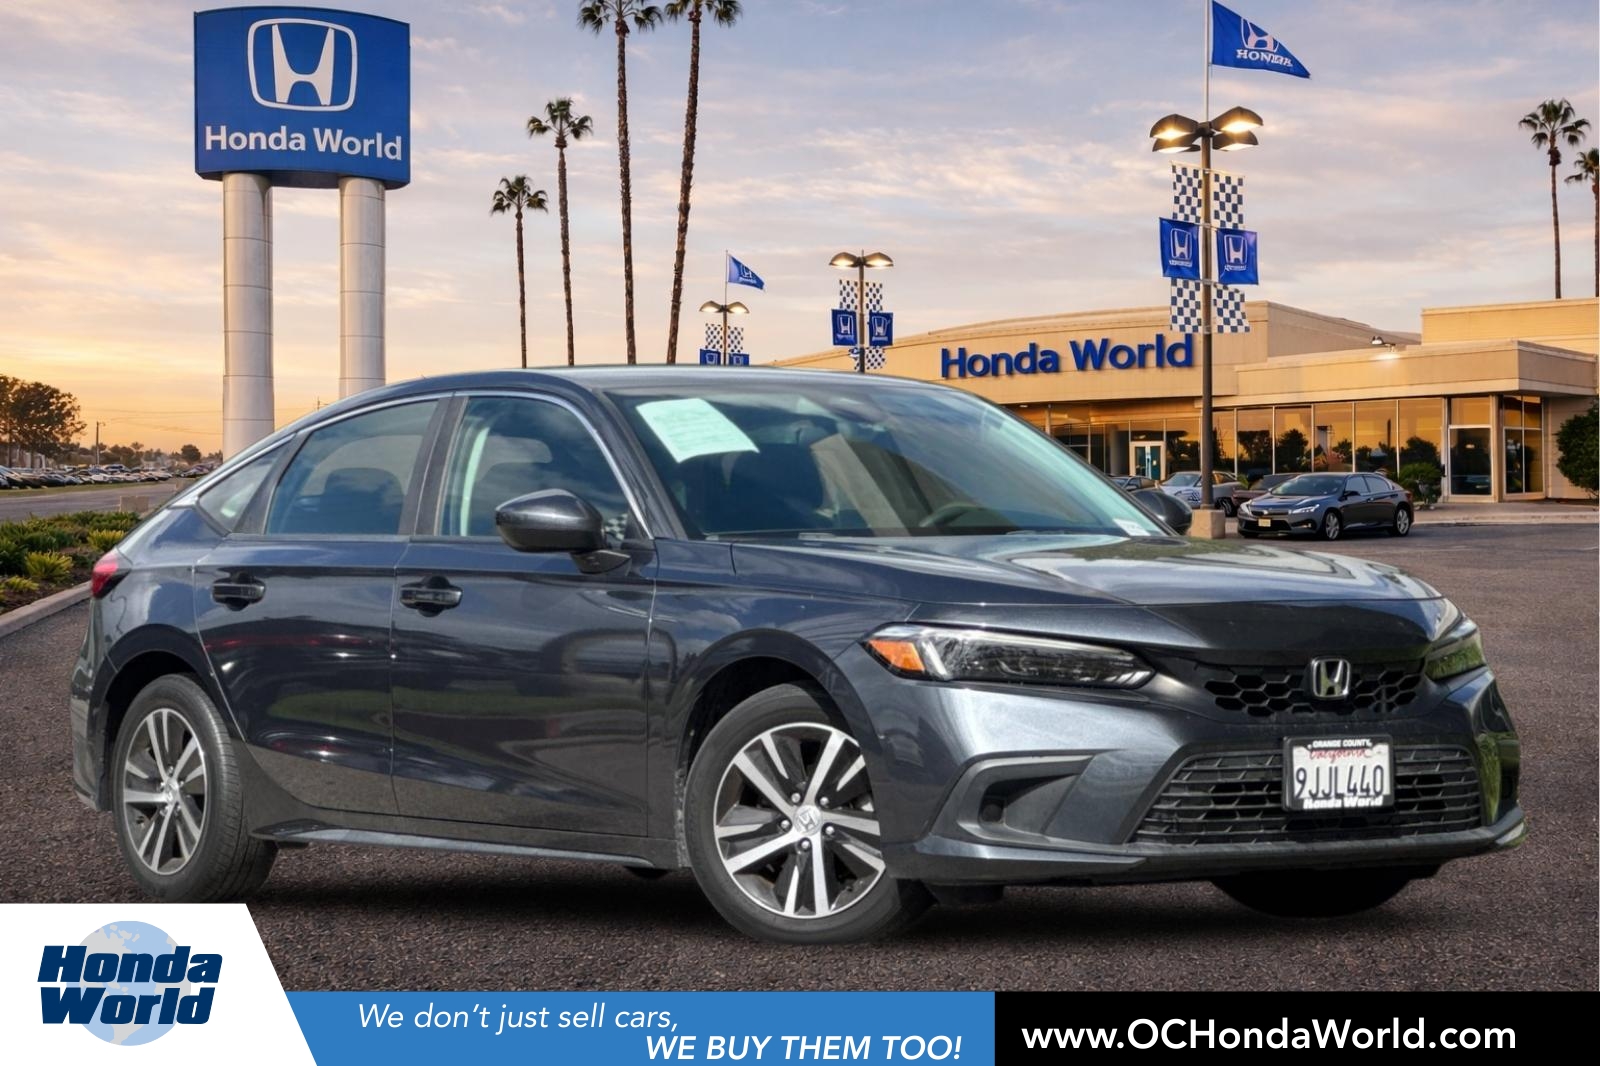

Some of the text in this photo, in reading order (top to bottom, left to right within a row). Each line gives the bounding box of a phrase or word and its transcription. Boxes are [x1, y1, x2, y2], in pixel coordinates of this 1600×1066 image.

[205, 125, 403, 161] Honda World
[941, 333, 1193, 378] Honda World
[1342, 739, 1371, 747] COUNTY
[1295, 764, 1385, 800] 9JJL440
[1303, 797, 1342, 810] Honda
